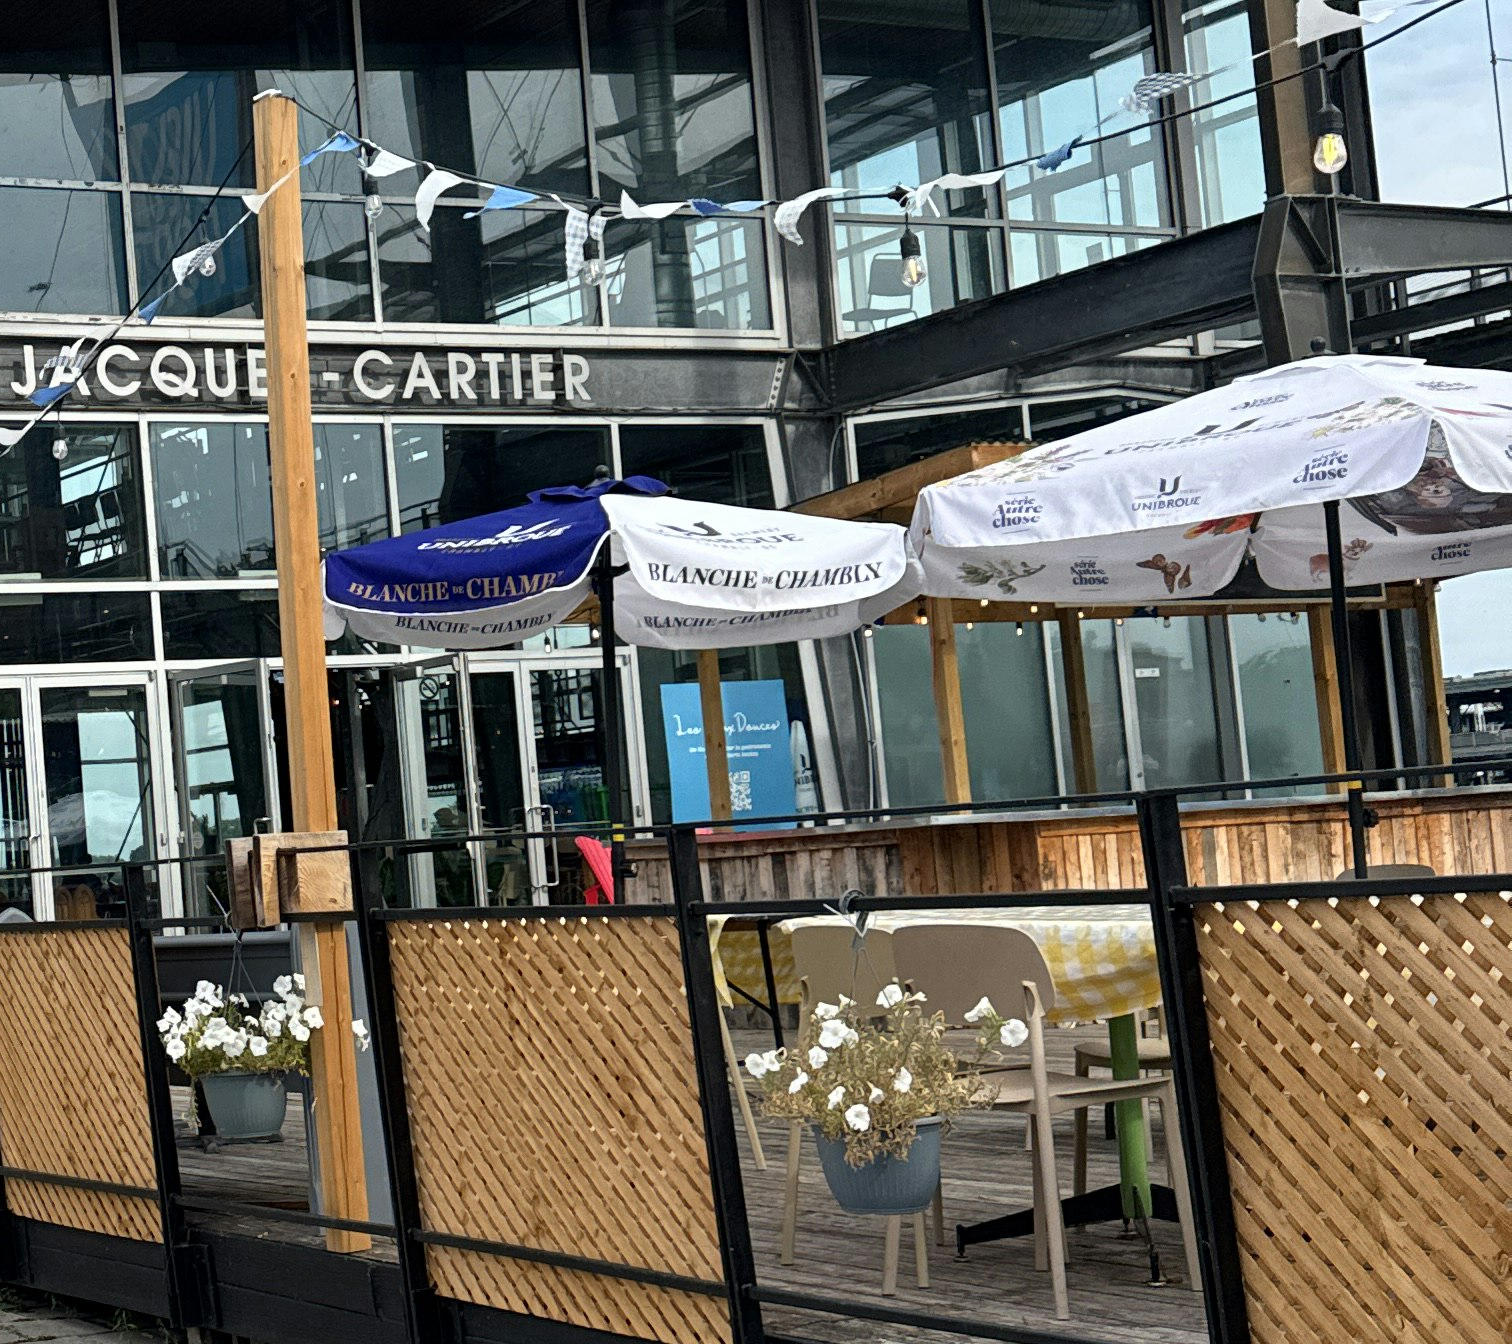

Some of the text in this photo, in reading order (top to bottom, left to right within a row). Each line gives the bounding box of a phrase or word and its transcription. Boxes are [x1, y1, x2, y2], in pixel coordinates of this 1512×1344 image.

[10, 343, 591, 401] JACQUE-CARTIER
[1004, 496, 1036, 506] série
[1131, 496, 1202, 512] UNIBROUE
[992, 504, 1044, 516] Autre
[992, 513, 1041, 528] chose
[417, 524, 572, 550] UNIBROUE
[647, 562, 758, 589] BLANCHE
[775, 561, 883, 590] CHAMBLY
[1070, 566, 1106, 575] Autre
[1072, 574, 1109, 586] chose
[346, 581, 449, 603] BLANCHE
[395, 613, 554, 635] BLANCHE CHAMBLY
[644, 616, 717, 629] BLANCHE
